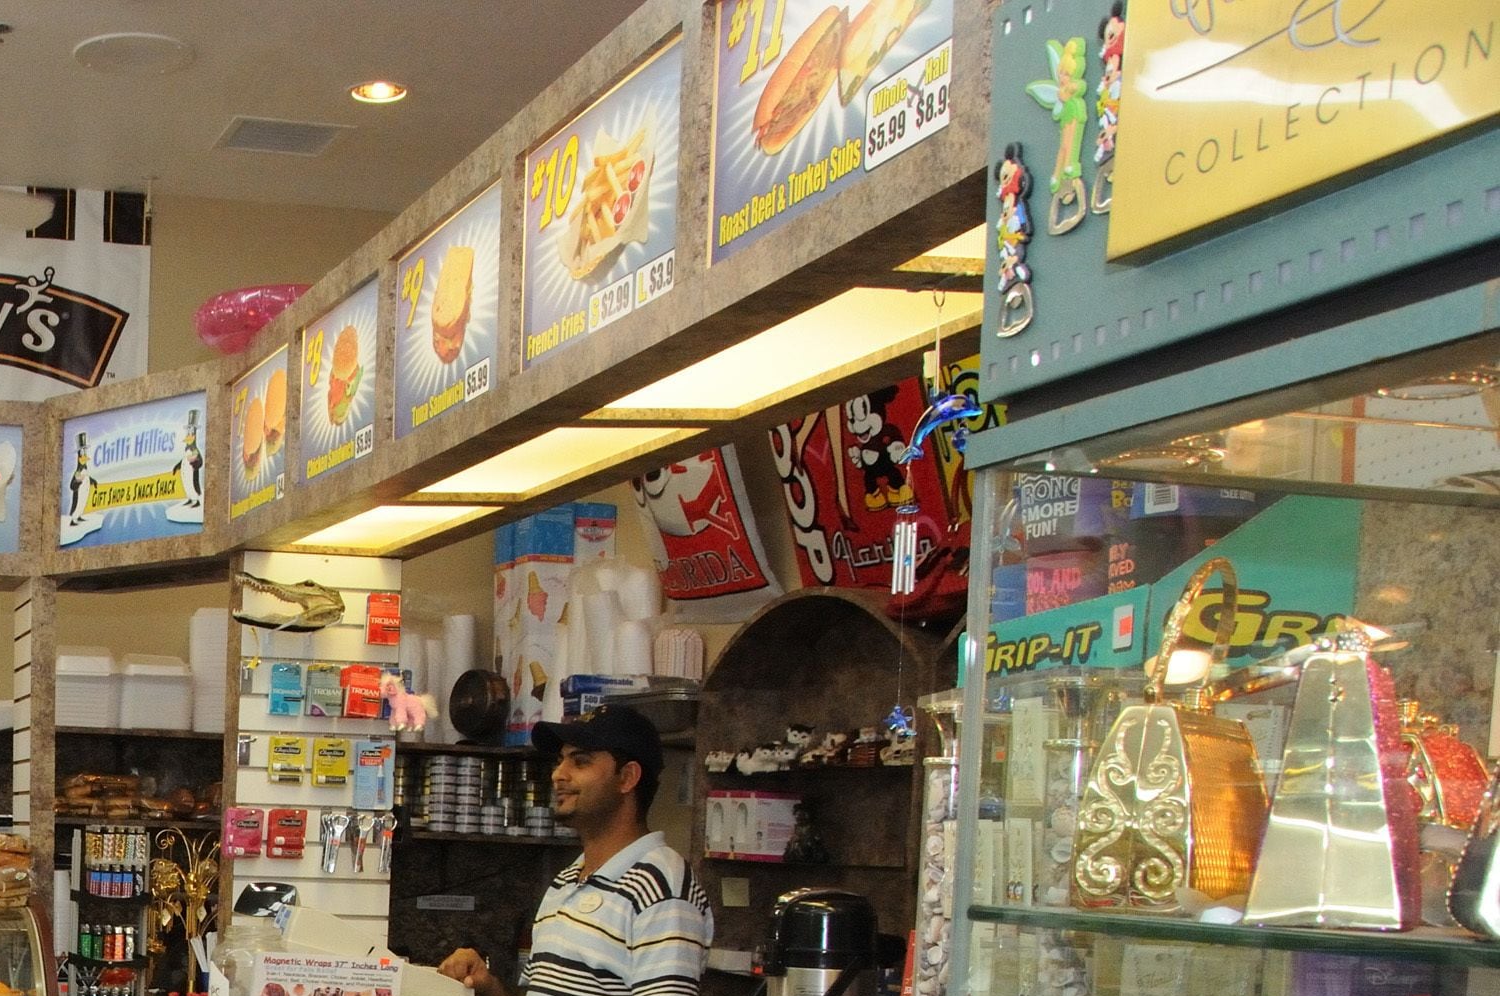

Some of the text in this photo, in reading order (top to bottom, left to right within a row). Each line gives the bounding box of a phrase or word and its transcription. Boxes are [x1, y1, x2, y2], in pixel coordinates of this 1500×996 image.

[872, 46, 950, 118] Whole Half
[1164, 22, 1493, 186] COLLECTION
[868, 109, 906, 157] $5.99
[531, 134, 579, 231] #10
[719, 138, 861, 247] Roast Beef & Turkey Subs
[402, 256, 425, 328] #9
[600, 280, 631, 322] $2.99
[649, 256, 675, 291] $3.9
[306, 329, 325, 386] #8
[526, 325, 558, 361] French
[559, 309, 586, 343] Fries
[412, 377, 464, 428] Tuna Sandwich
[465, 362, 488, 396] $5.99
[93, 428, 175, 467] Chilli Hillies
[356, 428, 372, 457] $5.99
[91, 490, 107, 507] GIFT
[108, 486, 125, 503] SHOP
[133, 483, 154, 501] SNACK
[155, 478, 177, 498] SHACK
[1025, 518, 1058, 540] FUN!
[665, 545, 754, 592] ORIDA
[370, 617, 400, 626] TROJAN
[351, 687, 380, 696] TROJAN
[263, 955, 302, 967] Magnetic
[305, 958, 332, 969] Wraps
[351, 961, 378, 971] Inches
